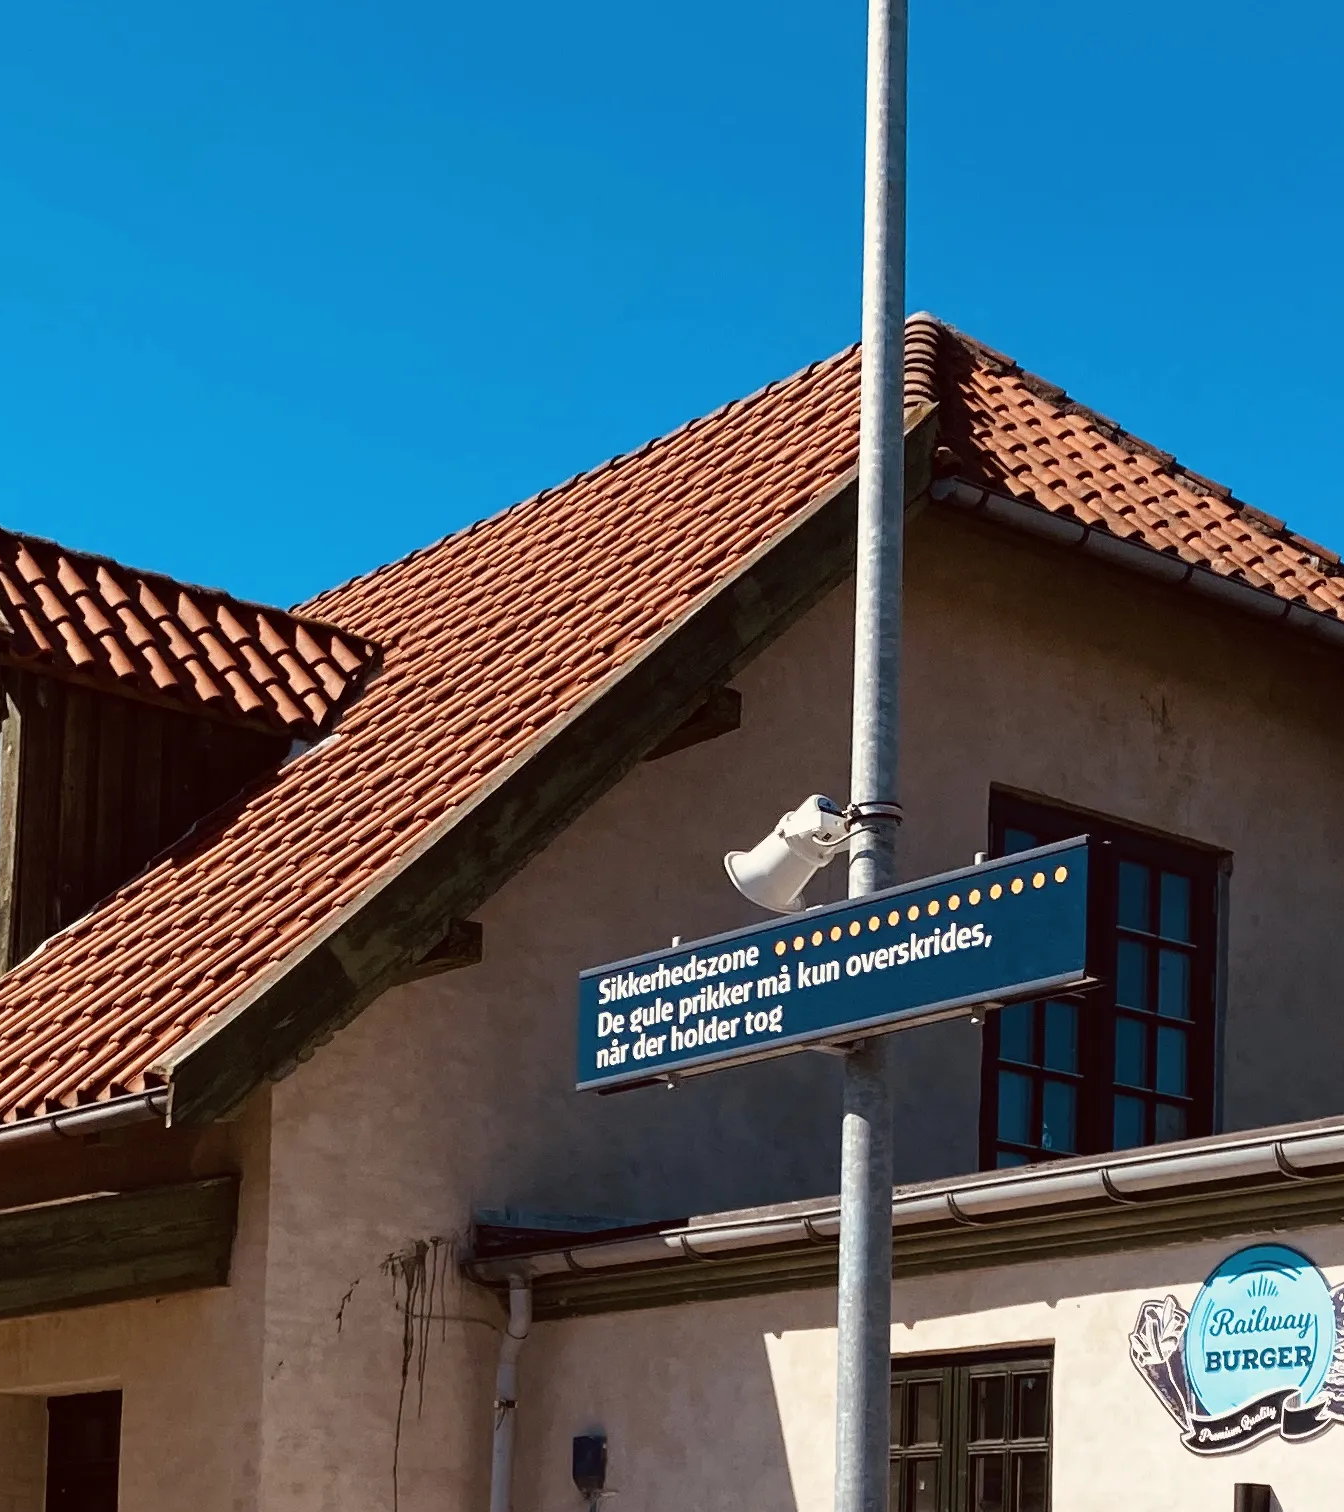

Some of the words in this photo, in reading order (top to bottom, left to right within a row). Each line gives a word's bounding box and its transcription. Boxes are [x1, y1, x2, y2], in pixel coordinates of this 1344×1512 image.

[597, 943, 760, 1005] Sikkerhedszone
[597, 1008, 625, 1038] De
[629, 998, 674, 1034] gule
[678, 979, 752, 1024] prikker
[756, 963, 792, 1000] må
[796, 959, 841, 991] kun
[845, 920, 993, 977] overskrides,
[596, 1040, 628, 1069] når
[631, 1029, 665, 1060] der
[669, 1013, 741, 1053] holder
[743, 1004, 784, 1034] tog
[1208, 1304, 1315, 1338] Railway
[1204, 1345, 1314, 1373] BURGER
[1198, 1418, 1243, 1443] Premium
[1240, 1404, 1277, 1432] Quality
